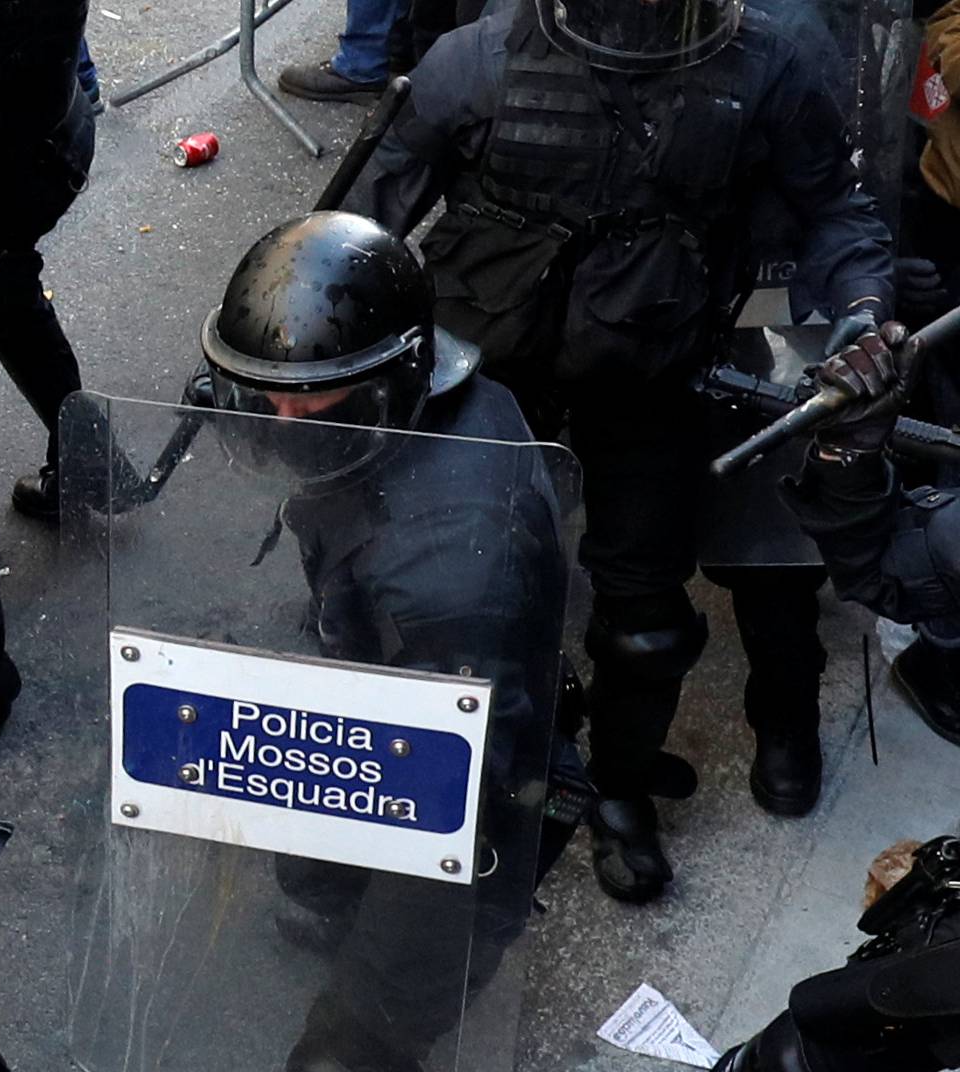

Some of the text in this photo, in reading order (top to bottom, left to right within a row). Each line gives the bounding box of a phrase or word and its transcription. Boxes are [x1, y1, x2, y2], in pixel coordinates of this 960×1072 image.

[232, 701, 373, 751] Policia
[220, 731, 382, 784] Mossos
[184, 759, 418, 821] d'Esquadra
